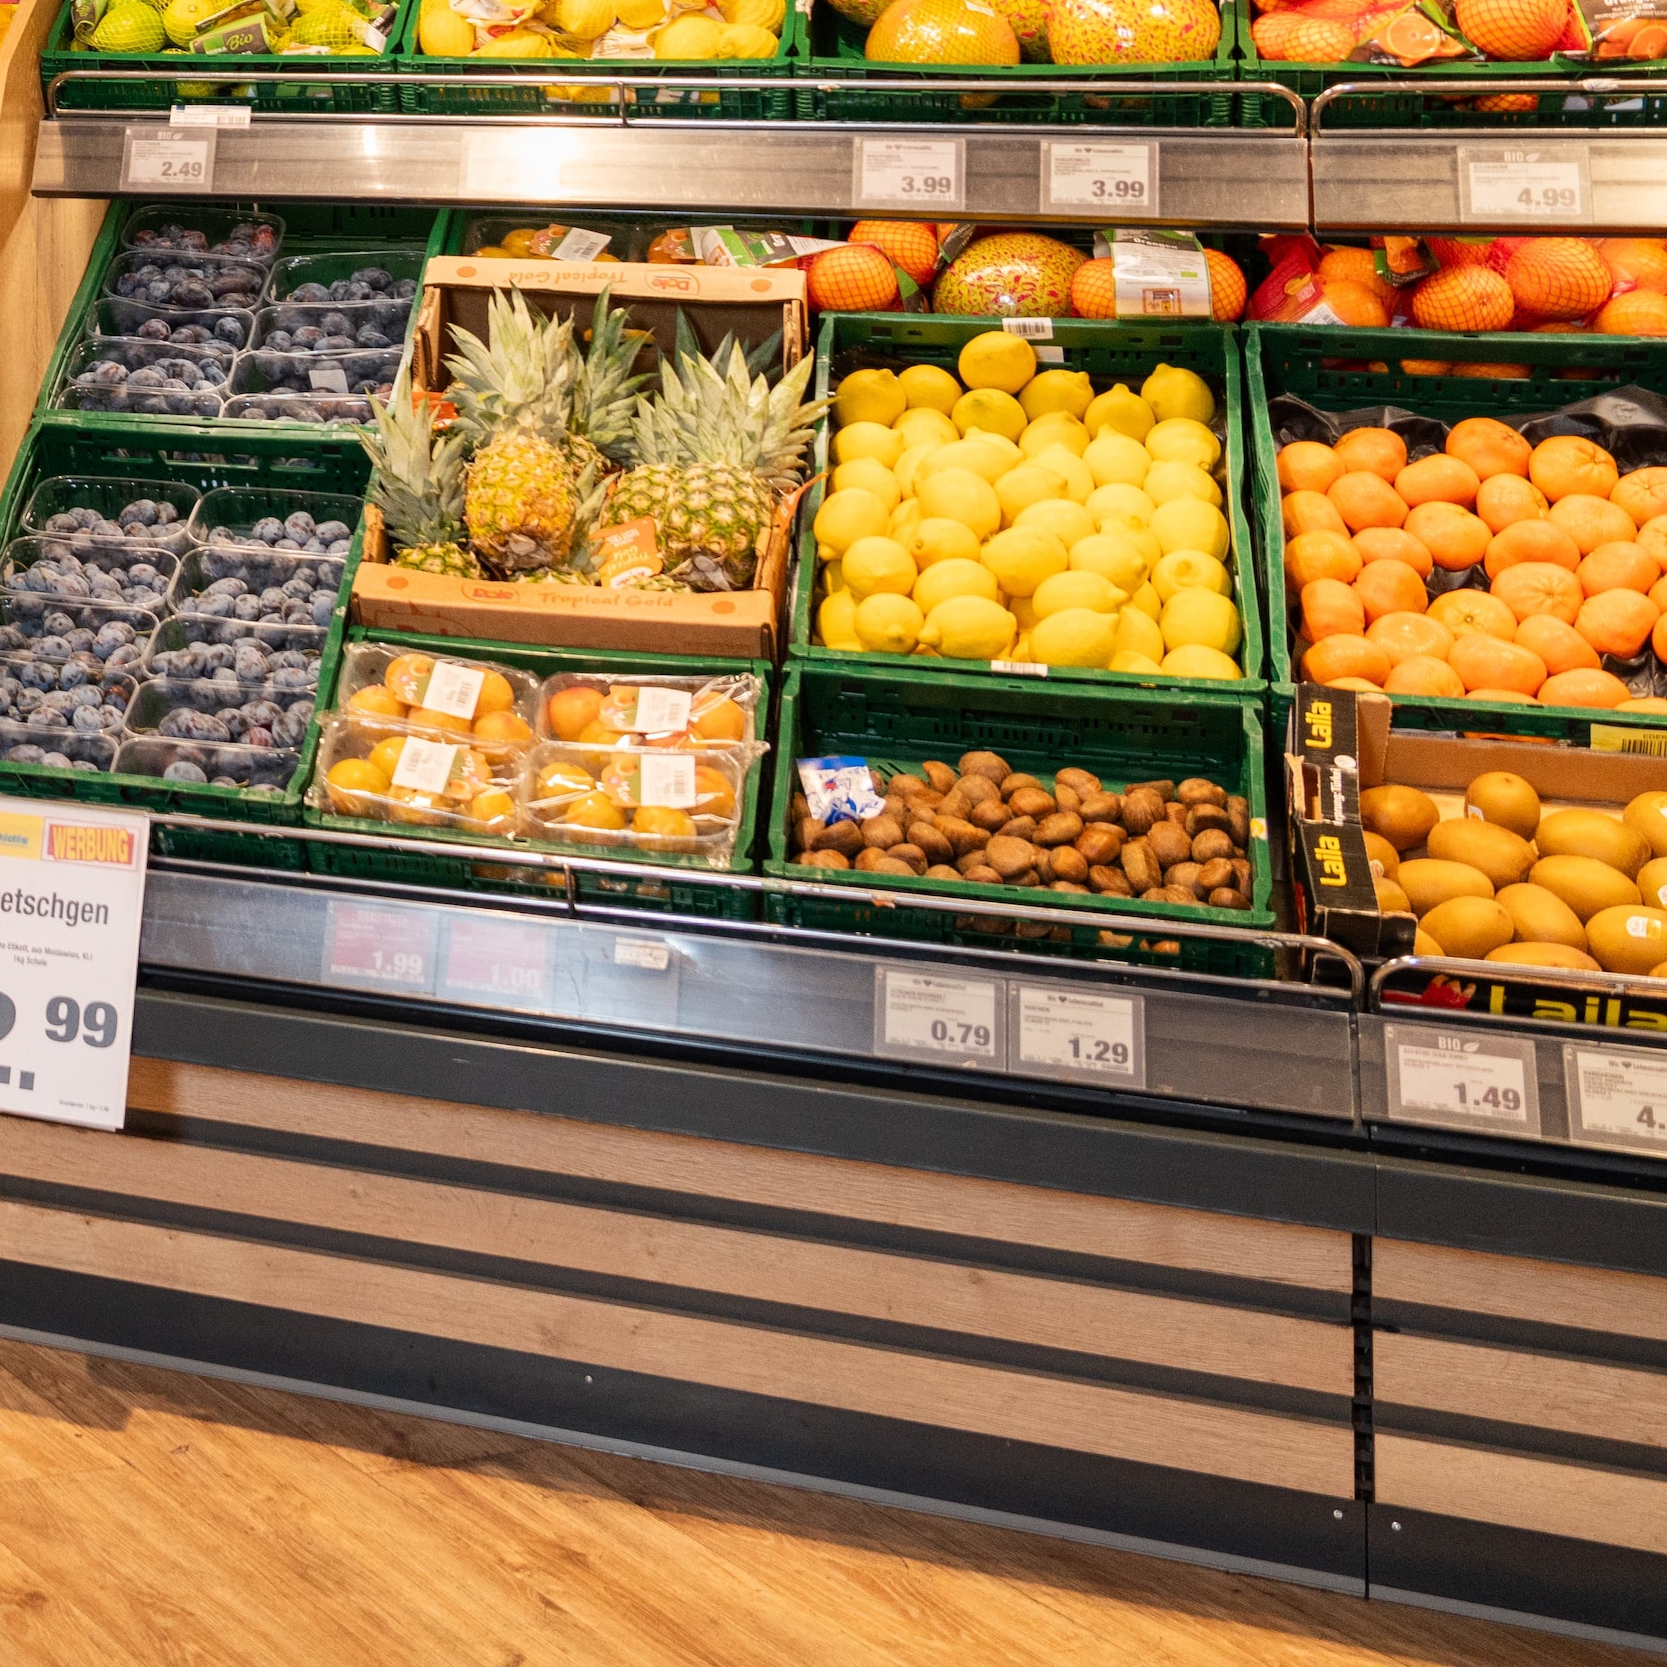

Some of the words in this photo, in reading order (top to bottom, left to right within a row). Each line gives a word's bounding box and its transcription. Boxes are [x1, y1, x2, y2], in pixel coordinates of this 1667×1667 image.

[226, 32, 254, 51] Bio
[157, 131, 171, 140] BIO
[1504, 151, 1524, 162] BIO
[161, 161, 203, 177] 2.49
[901, 176, 952, 194] 3.99
[1091, 180, 1145, 198] 3.99
[1517, 187, 1576, 207] 4.99
[509, 270, 551, 283] Gold
[553, 271, 627, 285] Tropical
[473, 588, 514, 601] Dole
[538, 591, 611, 609] Tropical
[619, 593, 673, 608] Gold
[1305, 701, 1334, 749] Laila
[52, 825, 129, 864] WERBUNG
[1314, 835, 1348, 887] Laila
[27, 955, 47, 966] Schale
[372, 949, 424, 973] 1.99
[931, 1019, 991, 1047] 0.79
[1068, 1037, 1129, 1065] 1.29
[1438, 1036, 1461, 1051] BIO
[1454, 1081, 1521, 1111] 1.49
